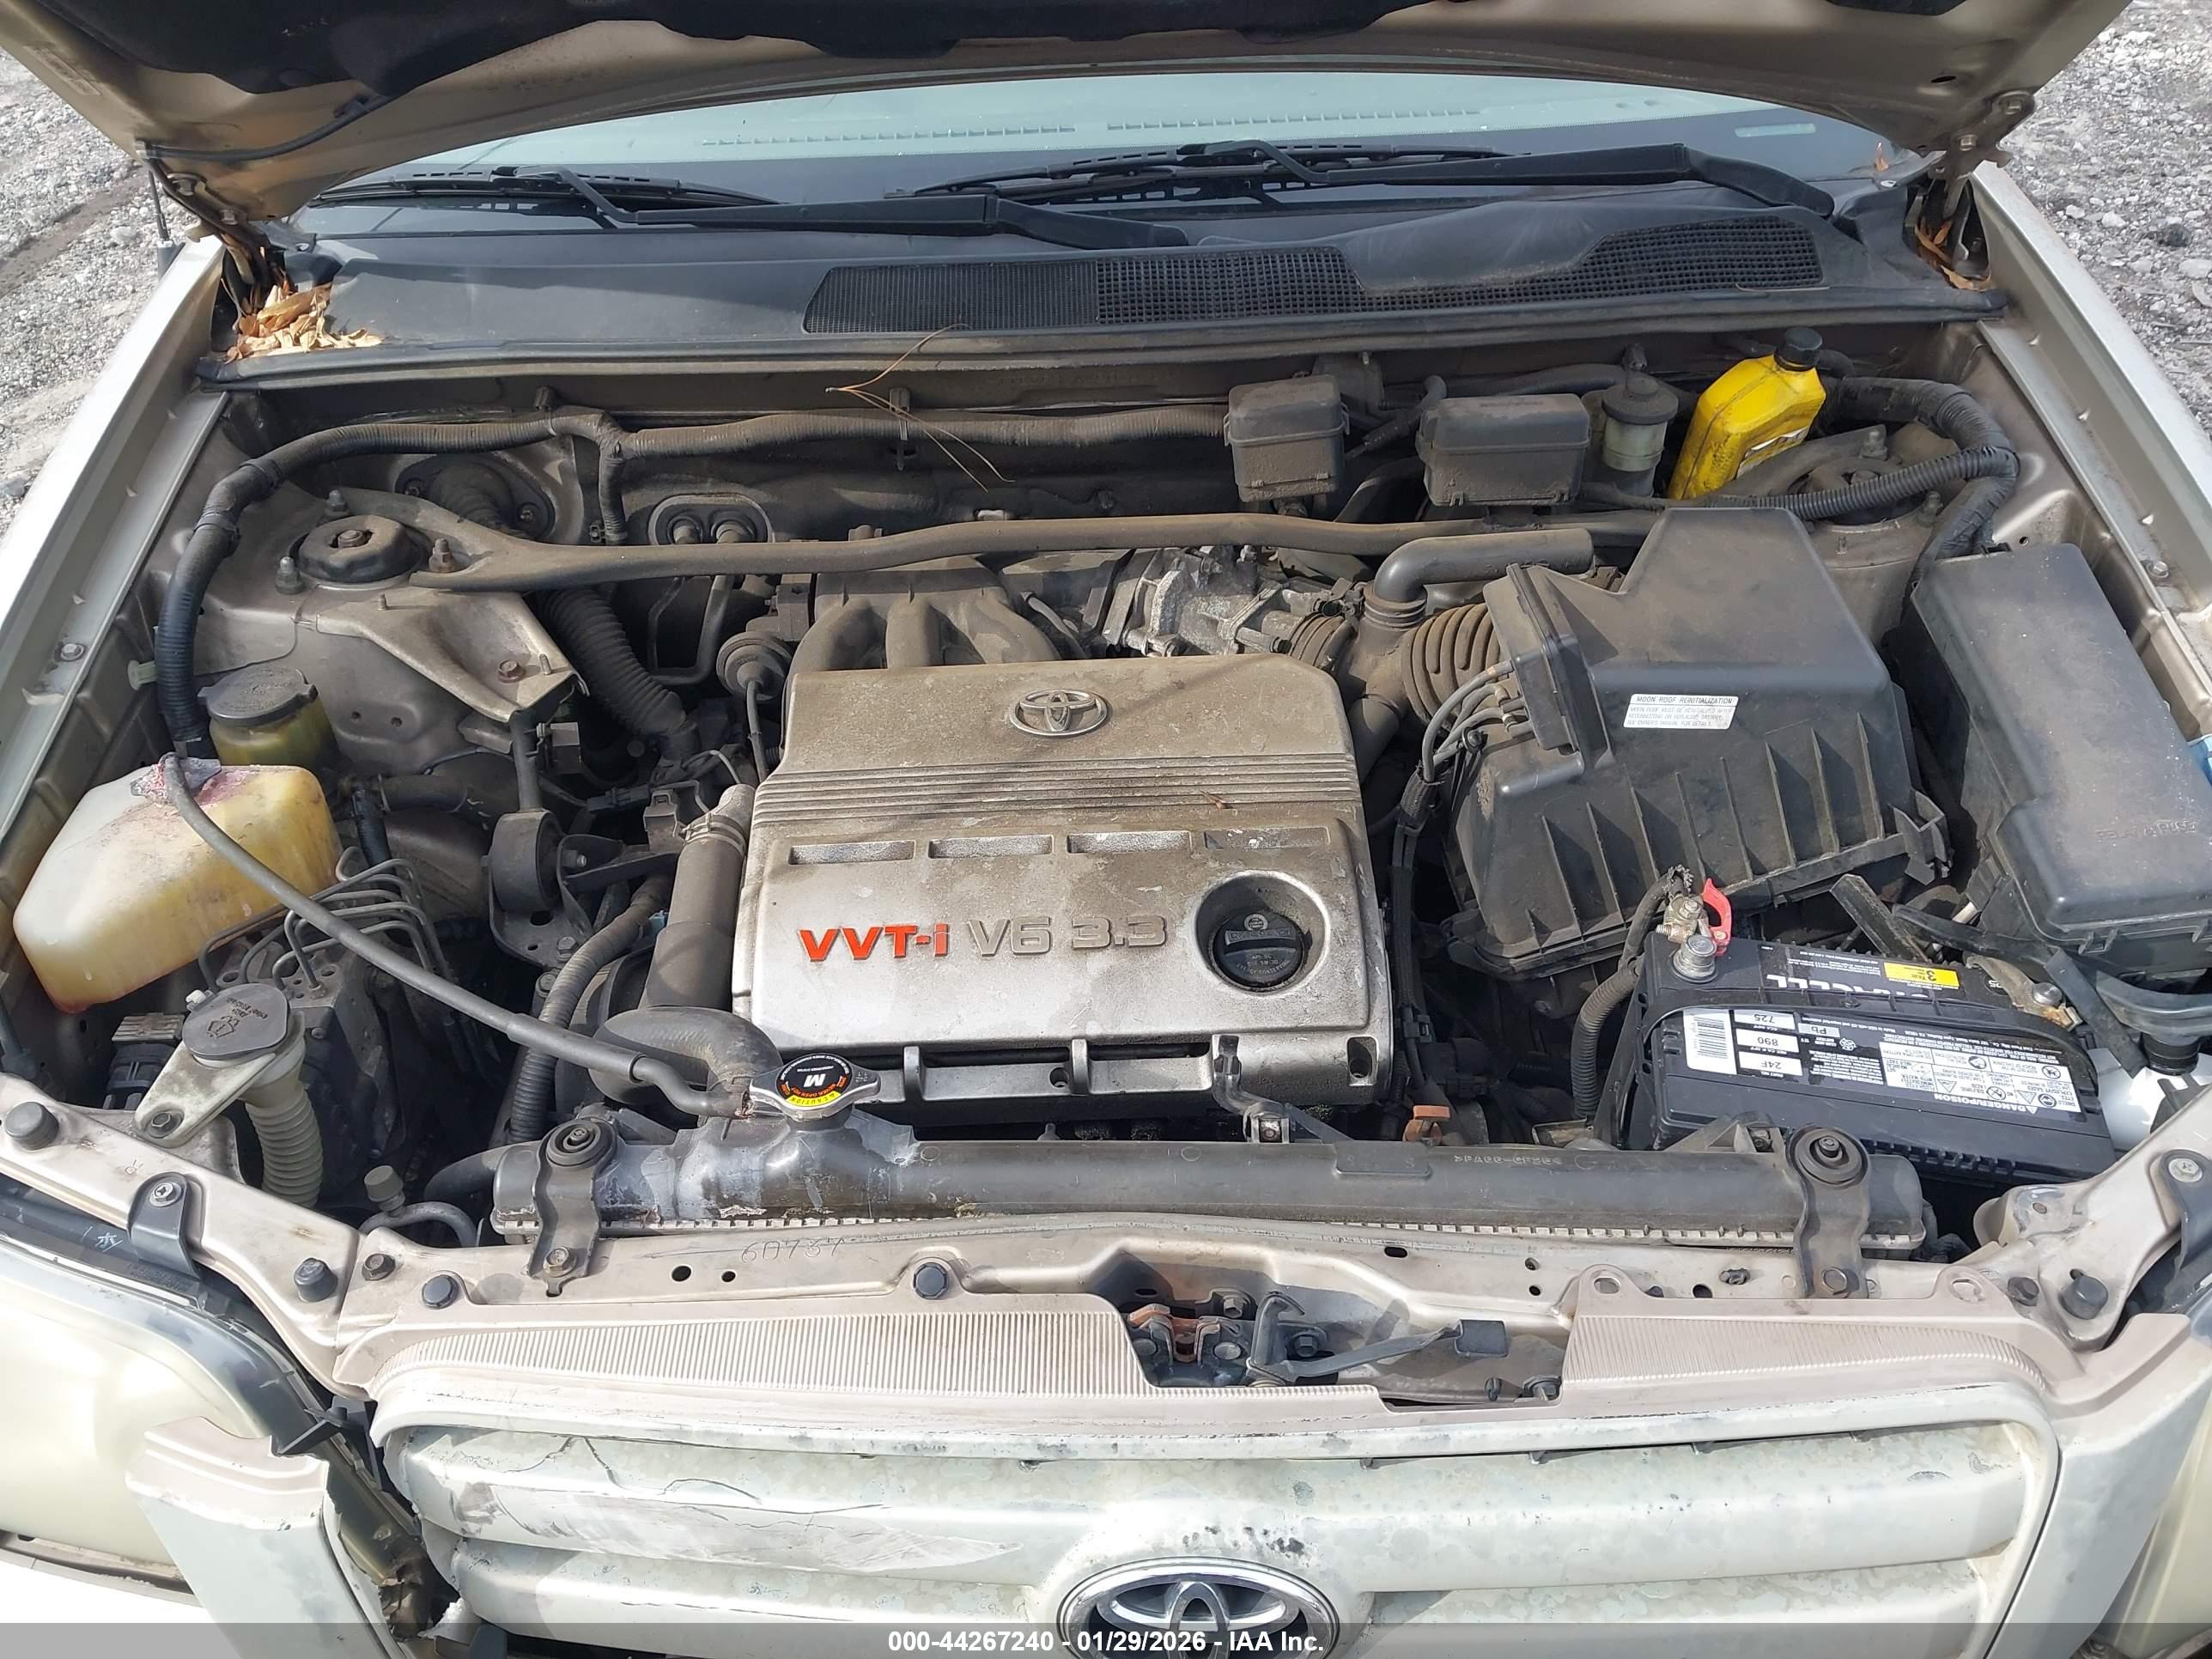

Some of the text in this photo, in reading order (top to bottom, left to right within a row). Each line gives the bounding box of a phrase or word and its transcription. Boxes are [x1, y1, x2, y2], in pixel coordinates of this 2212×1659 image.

[2157, 818, 2198, 836] FUSE
[798, 915, 1168, 962] VVT-i V6 3.3
[1926, 970, 1937, 981] 3
[1753, 1014, 1777, 1024] 725
[1810, 1026, 1827, 1035] Pb
[1757, 1036, 1778, 1047] 890
[1760, 1060, 1782, 1070] 24F
[803, 1073, 826, 1087] M
[789, 1097, 829, 1106] CAUTION
[1934, 1094, 2027, 1112] DANGER/POISON
